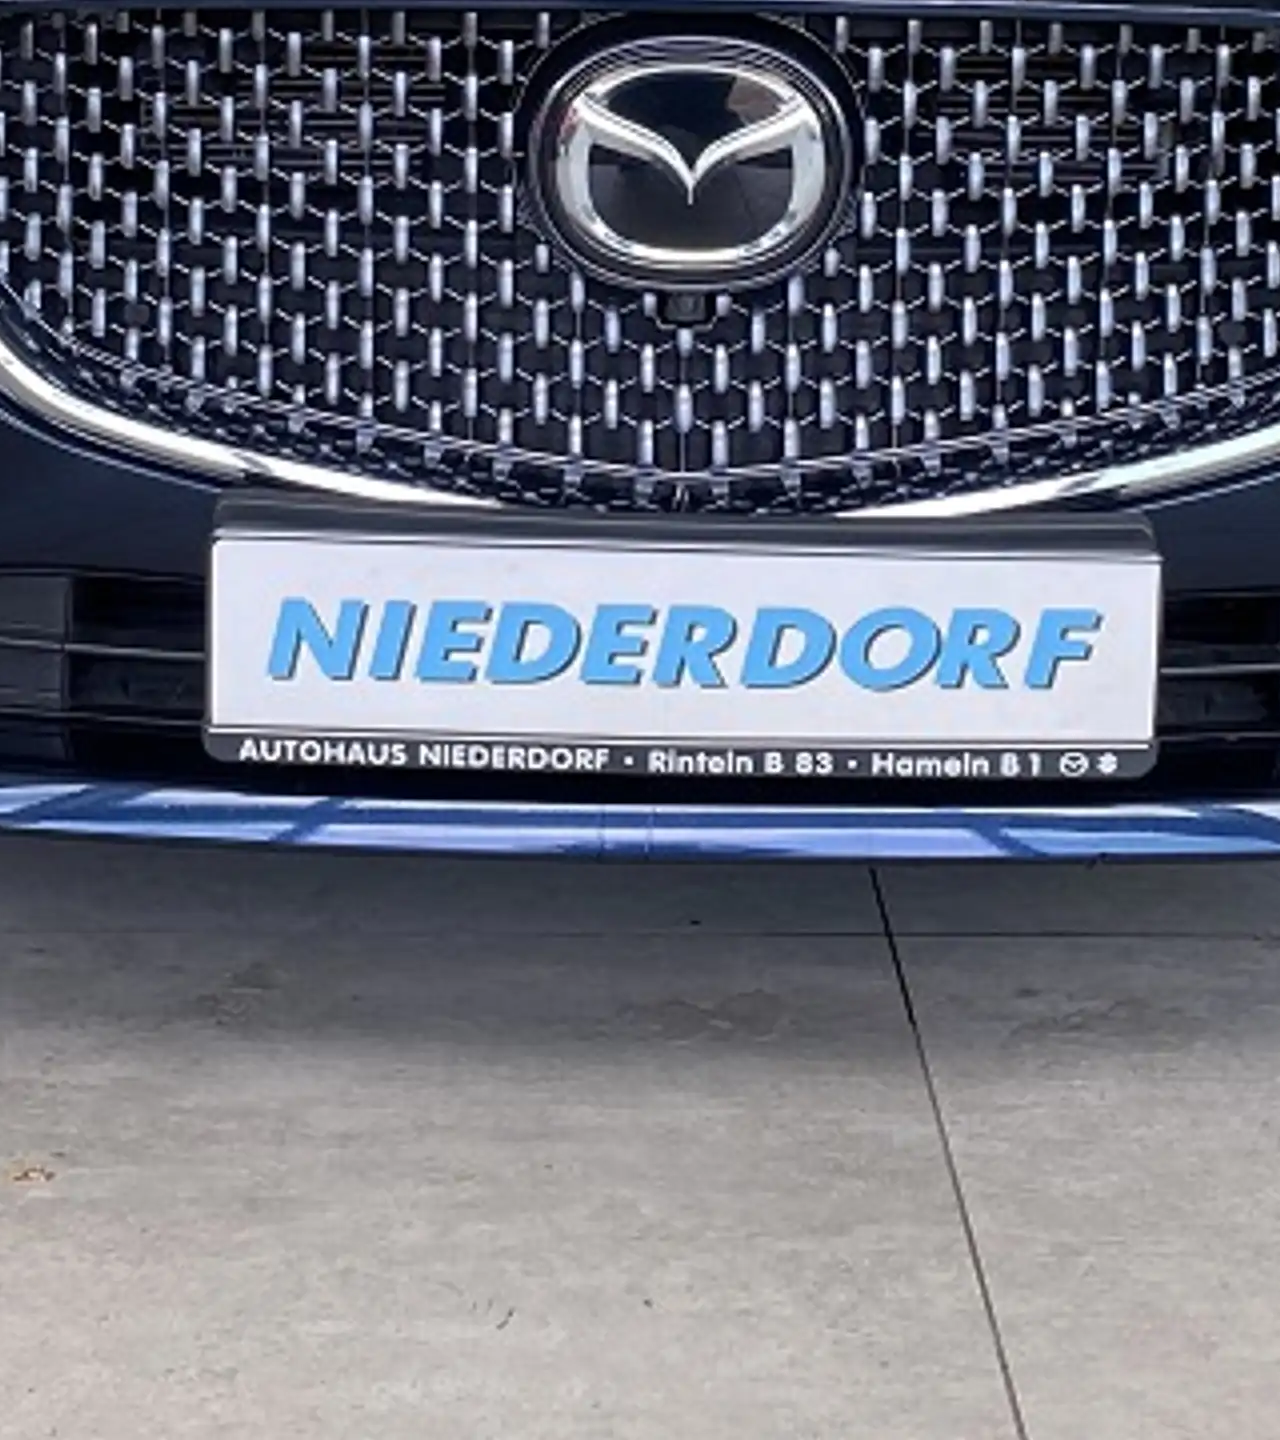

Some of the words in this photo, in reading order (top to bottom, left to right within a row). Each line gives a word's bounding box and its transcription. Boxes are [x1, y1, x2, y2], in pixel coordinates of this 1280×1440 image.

[266, 596, 1102, 692] NIEDERDORF
[238, 738, 408, 766] AUTOHAUS
[419, 743, 609, 771] NIEDERDORF
[647, 749, 754, 774] Rinteln
[795, 751, 834, 775] 83
[870, 751, 990, 777] Hameln
